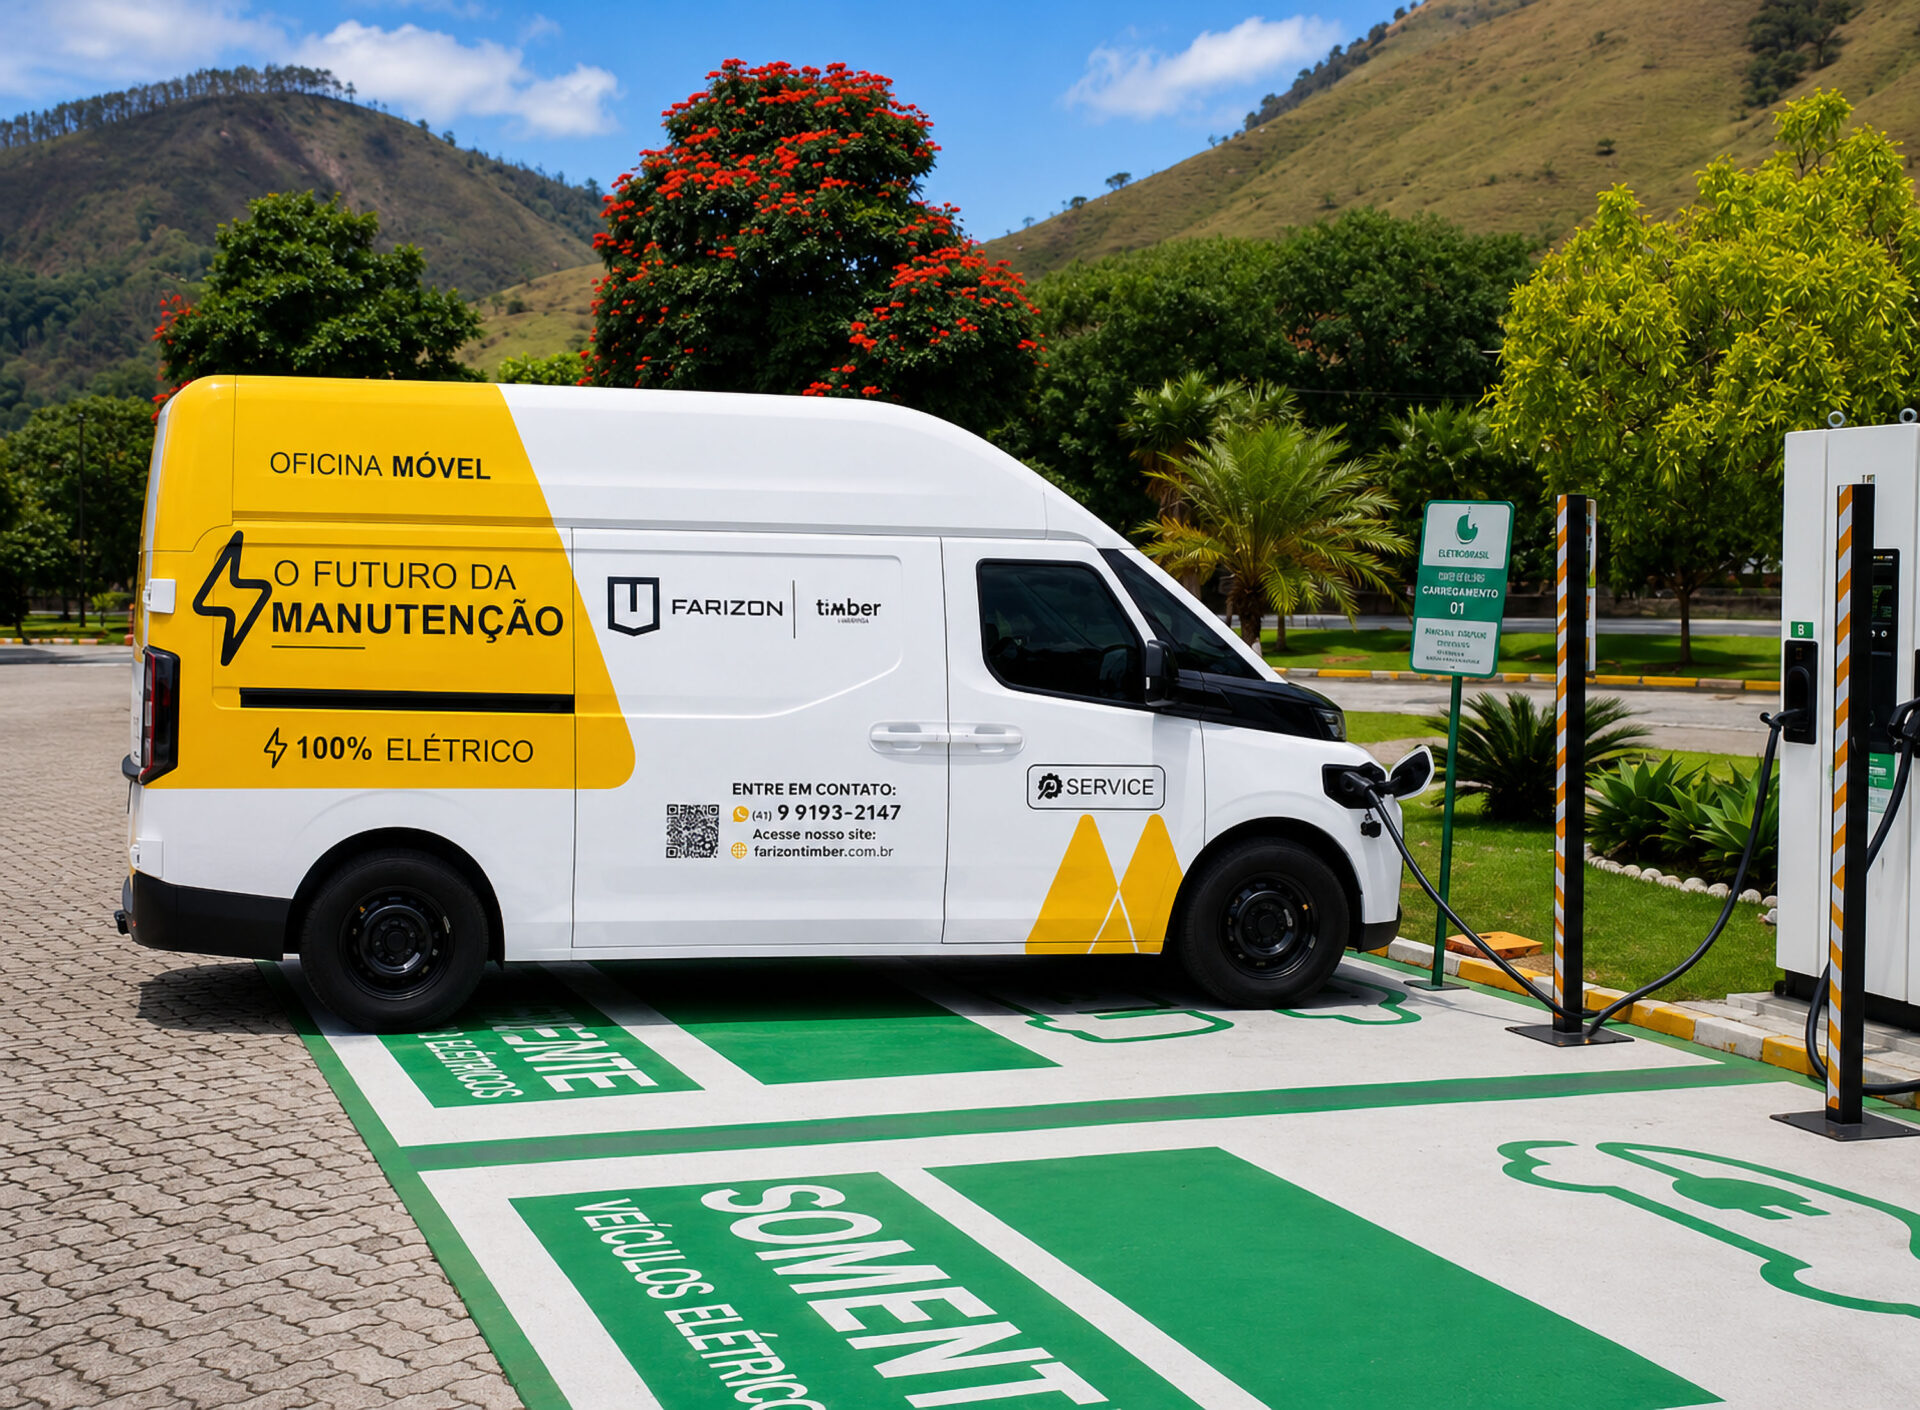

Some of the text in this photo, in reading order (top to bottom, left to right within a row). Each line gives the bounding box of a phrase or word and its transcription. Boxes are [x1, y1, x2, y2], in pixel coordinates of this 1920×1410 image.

[270, 451, 491, 480] OFICINA MÓVEL
[274, 560, 516, 590] O FUTURO DA
[1422, 585, 1499, 599] CARREGAMENTO
[672, 599, 783, 616] FARIZON
[816, 598, 881, 616] timber
[1450, 601, 1465, 615] 01
[271, 598, 564, 643] MANUTENÇÃO
[297, 733, 534, 763] 100% ELÉTRICO
[732, 782, 897, 796] ENTRE EM CONTATO:
[1066, 778, 1155, 795] SERVICE
[752, 804, 901, 822] (41) 9 9193-2147
[752, 829, 876, 840] Acesse nosso site:
[754, 845, 894, 858] farizontimber.com.br
[574, 1198, 715, 1299] VEÍCULOS
